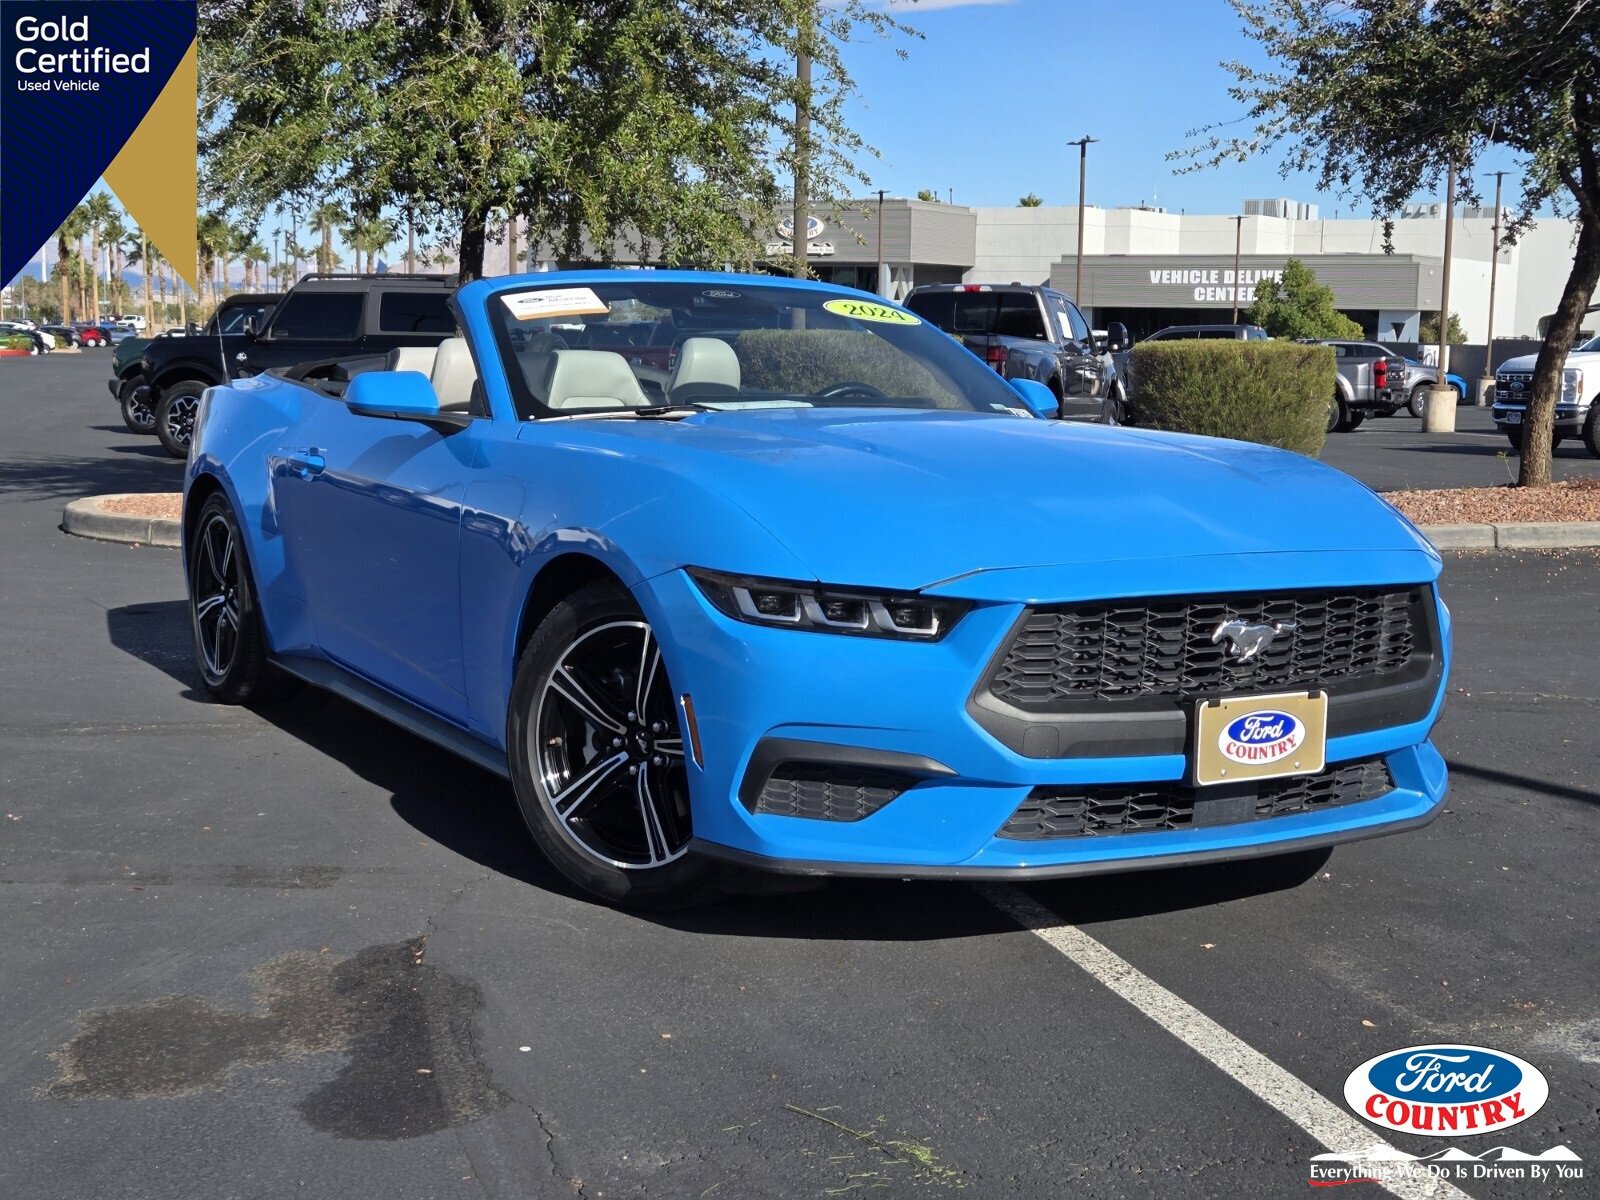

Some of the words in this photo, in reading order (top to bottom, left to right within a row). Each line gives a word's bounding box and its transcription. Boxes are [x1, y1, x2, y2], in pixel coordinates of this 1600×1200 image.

[1150, 269, 1219, 284] VEHICLE
[1223, 269, 1285, 285] DELIVE
[844, 303, 906, 321] 2024
[1240, 715, 1284, 742] Ford
[1226, 734, 1297, 760] COUNTRY
